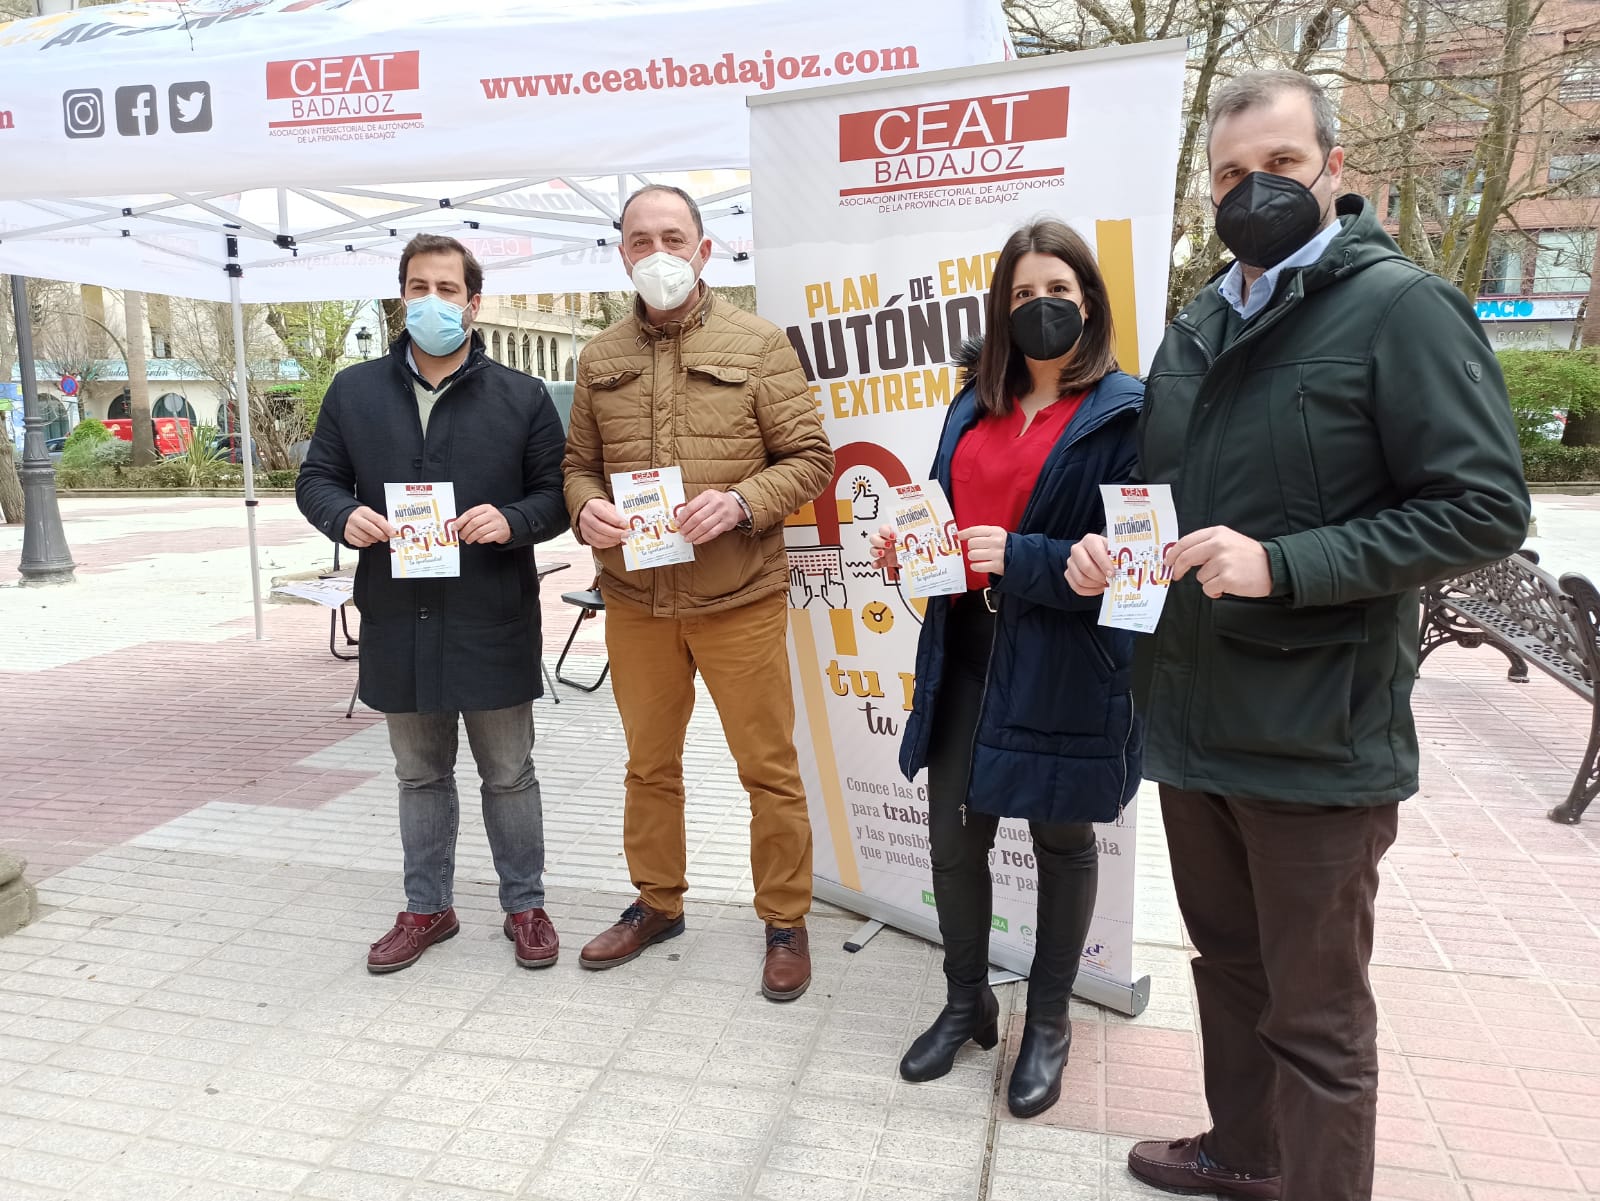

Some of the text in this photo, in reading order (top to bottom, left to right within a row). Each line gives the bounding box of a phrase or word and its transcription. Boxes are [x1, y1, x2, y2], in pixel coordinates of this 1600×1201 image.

[290, 54, 394, 96] CEAT
[480, 45, 919, 99] www.ceatbadajoz.com
[292, 94, 394, 118] BADAJOZ
[311, 125, 366, 134] INTERSECTORIAL
[367, 124, 376, 132] DE
[873, 94, 1029, 155] CEAT
[308, 135, 316, 143] LA
[318, 134, 354, 142] PROVINCIA
[875, 145, 1024, 184] BADAJOZ
[898, 187, 978, 201] INTERSECTORIAL
[979, 185, 993, 194] DE
[996, 177, 1065, 193] AUTÓNOMOS
[878, 192, 1019, 213] DE LA PROVINCIA DE BADAJOZ
[804, 273, 879, 318] PLAN
[909, 276, 935, 302] DE
[1474, 301, 1533, 318] PACIO
[786, 293, 991, 382] AUTÓNO
[808, 385, 825, 421] E
[1125, 488, 1145, 496] CEAT
[1114, 519, 1152, 536] AUTÓNOMO
[825, 659, 885, 698] tu
[857, 701, 898, 736] tu
[847, 777, 889, 796] Conoce
[892, 782, 914, 799] las
[852, 803, 880, 817] para
[856, 826, 862, 839] y
[865, 825, 885, 841] las
[860, 845, 881, 860] que
[885, 850, 930, 869] puedes
